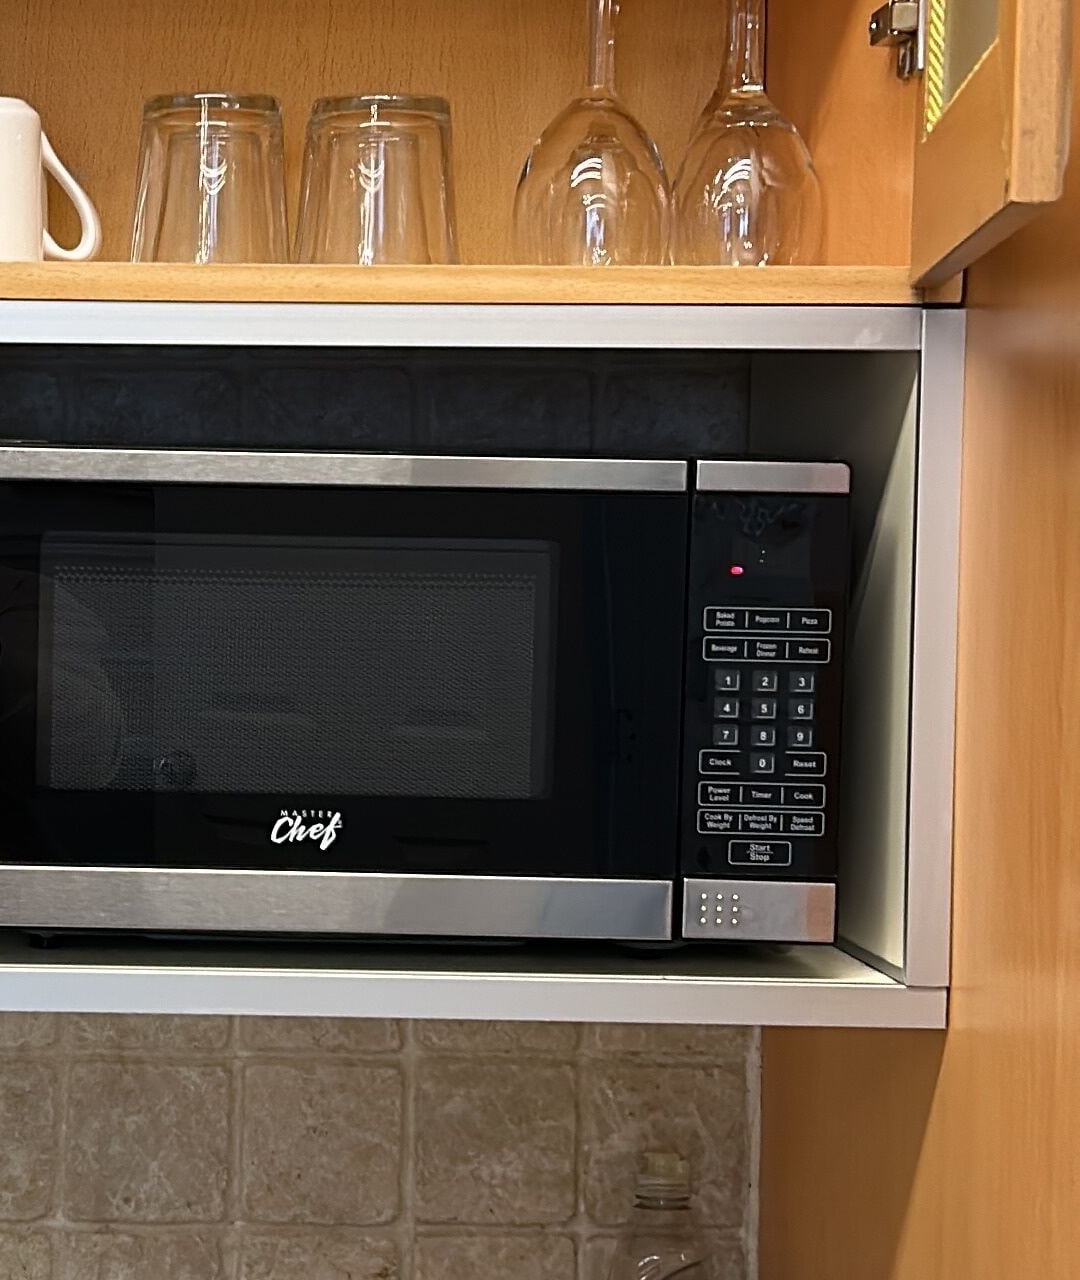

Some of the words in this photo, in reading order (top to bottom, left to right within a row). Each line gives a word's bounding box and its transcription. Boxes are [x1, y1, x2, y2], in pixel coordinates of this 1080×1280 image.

[801, 616, 819, 625] Pizza
[761, 677, 769, 687] 2
[798, 677, 806, 687] 3
[723, 703, 731, 713] 4
[761, 704, 768, 713] 5
[797, 705, 805, 714] 6
[722, 730, 730, 740] 7
[759, 731, 767, 741] 8
[796, 732, 804, 742] 9
[708, 758, 732, 766] Clock
[759, 758, 766, 768] 0
[792, 759, 817, 768] Reset
[707, 786, 731, 794] Power
[751, 790, 772, 799] Timer
[709, 793, 730, 802] Level
[793, 792, 814, 800] Cook
[280, 809, 333, 818] MASTER
[704, 813, 722, 821] Cook
[723, 813, 733, 822] By
[270, 811, 343, 851] Chef
[749, 843, 771, 852] Start
[749, 852, 770, 862] Stop
